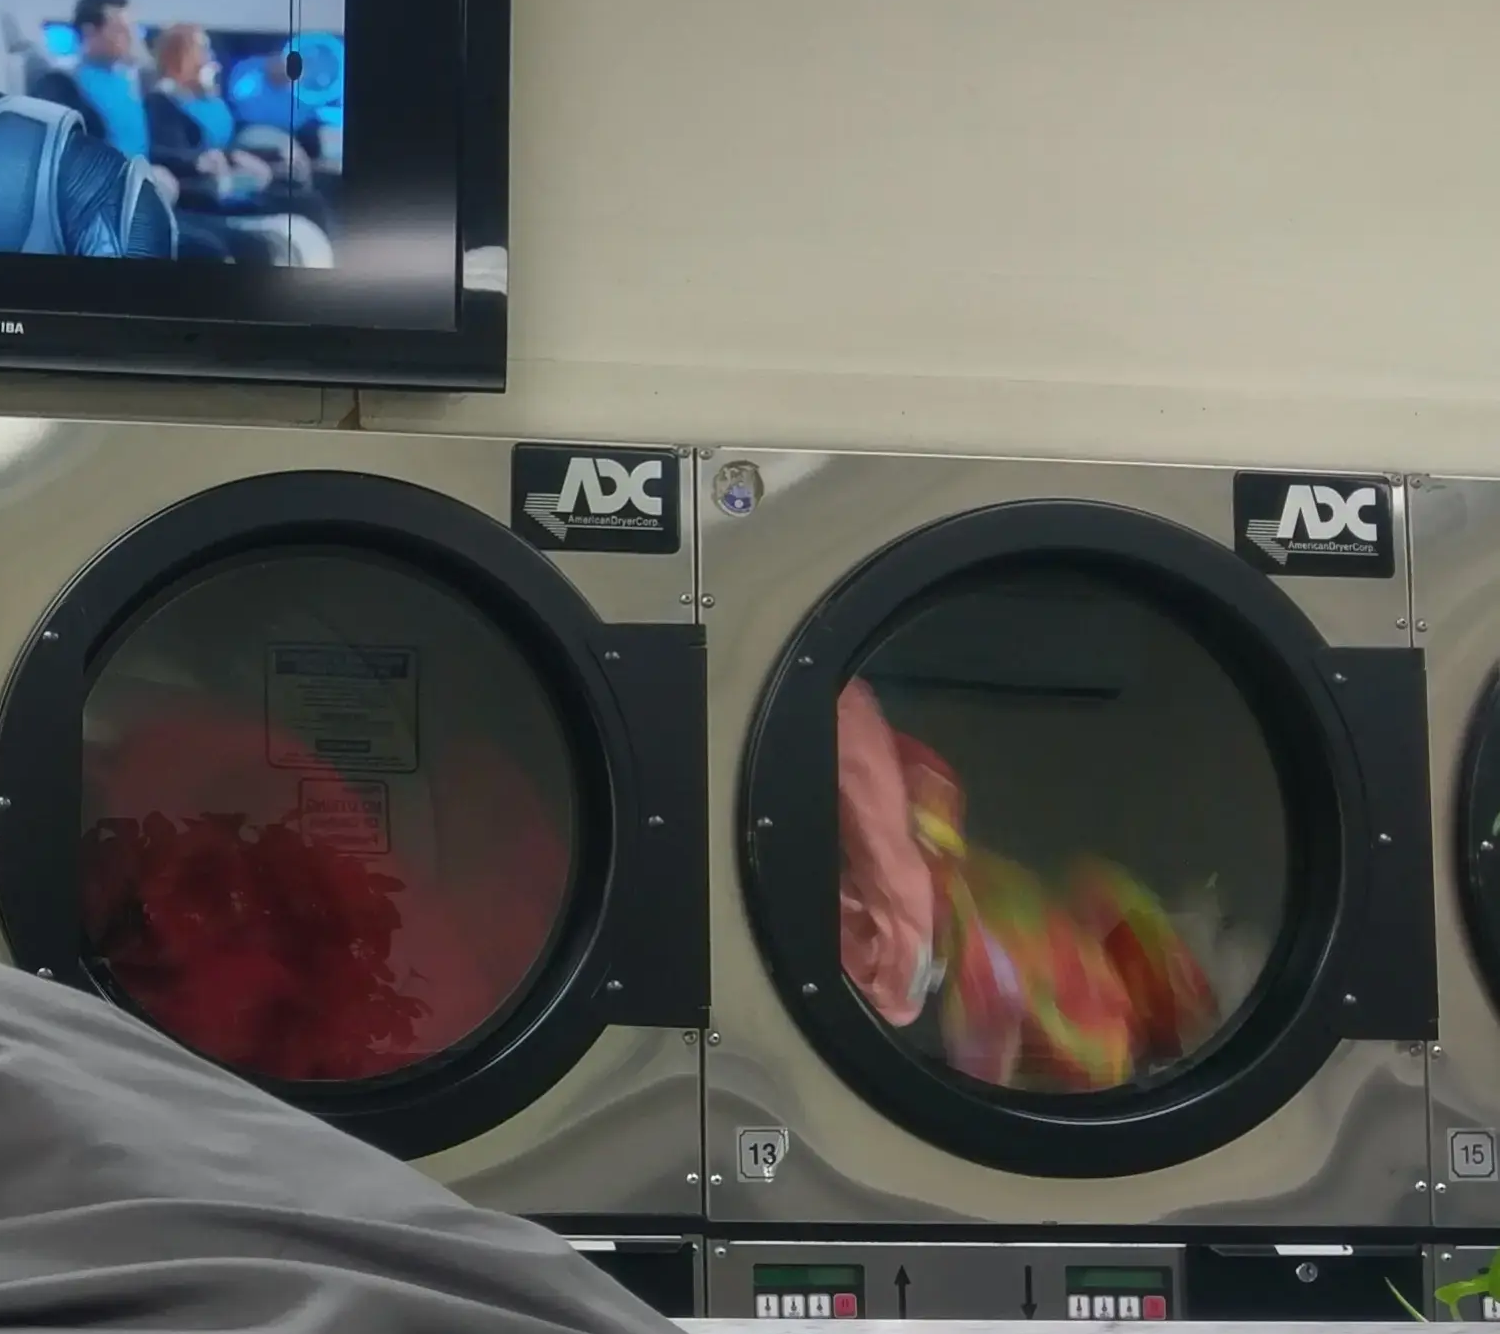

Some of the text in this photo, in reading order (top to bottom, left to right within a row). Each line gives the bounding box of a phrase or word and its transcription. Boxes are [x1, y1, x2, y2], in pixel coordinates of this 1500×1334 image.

[556, 457, 662, 515] ADC
[1276, 485, 1377, 541] ADC
[749, 1143, 776, 1165] 13
[1460, 1144, 1484, 1164] 15
